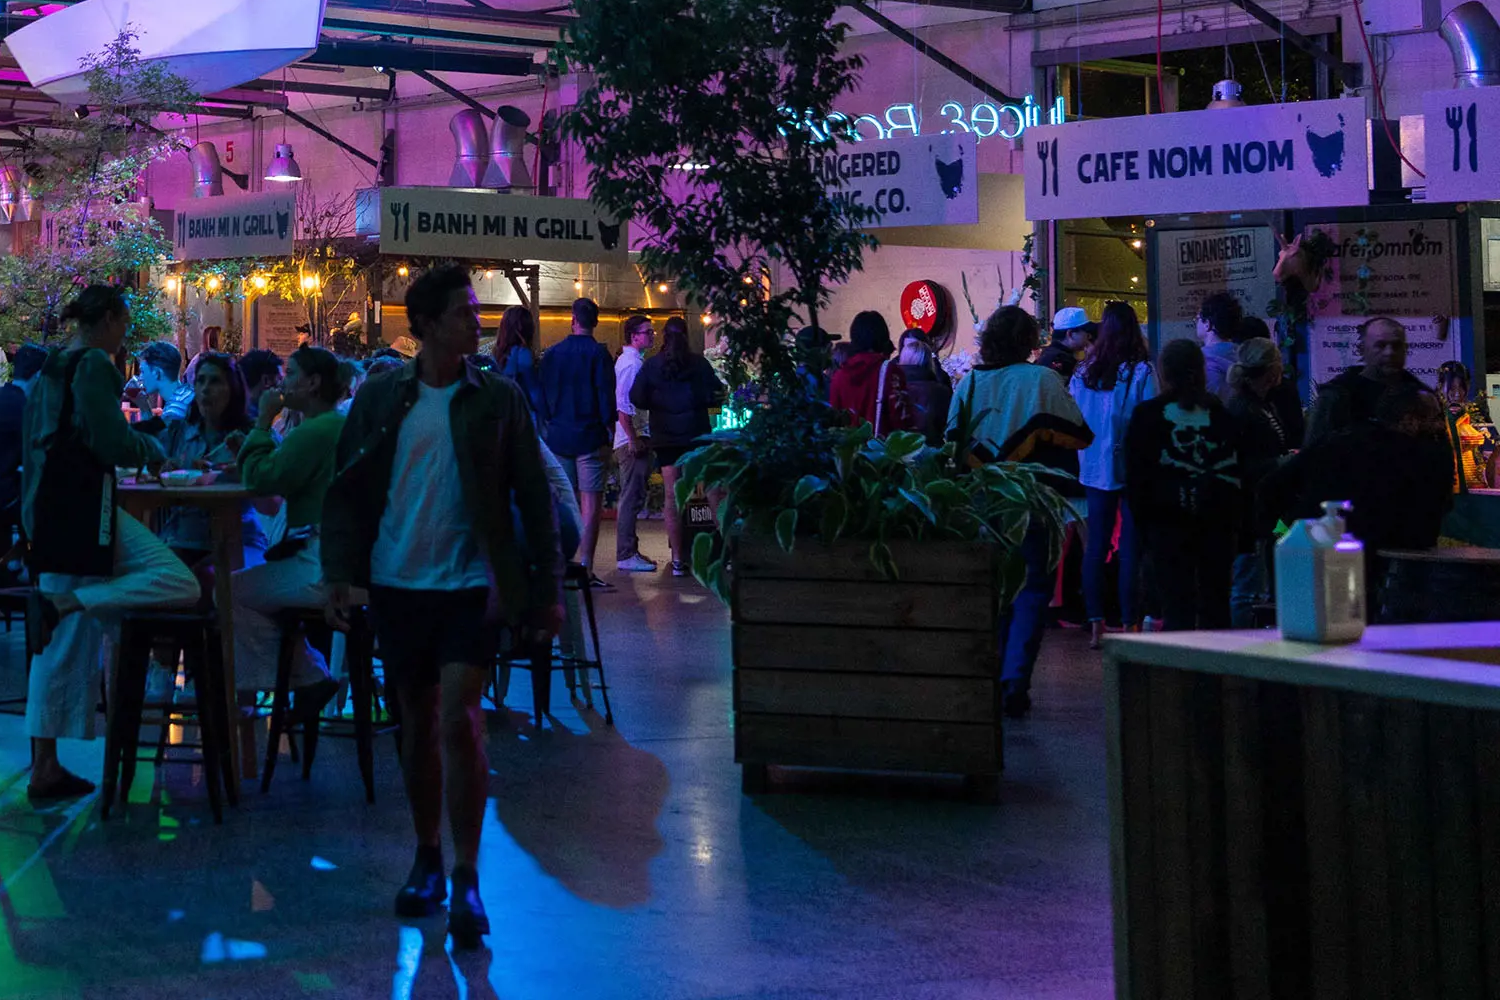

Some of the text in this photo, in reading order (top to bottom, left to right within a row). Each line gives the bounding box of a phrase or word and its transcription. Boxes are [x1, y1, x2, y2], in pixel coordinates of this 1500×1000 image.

[226, 141, 234, 163] 5
[1077, 139, 1294, 184] CAFE NOM NOM
[875, 188, 910, 214] CO.
[188, 214, 274, 239] BANH MI N GRILL
[417, 211, 595, 241] BANH MI N GRILL
[1180, 234, 1252, 264] ENDANGERED
